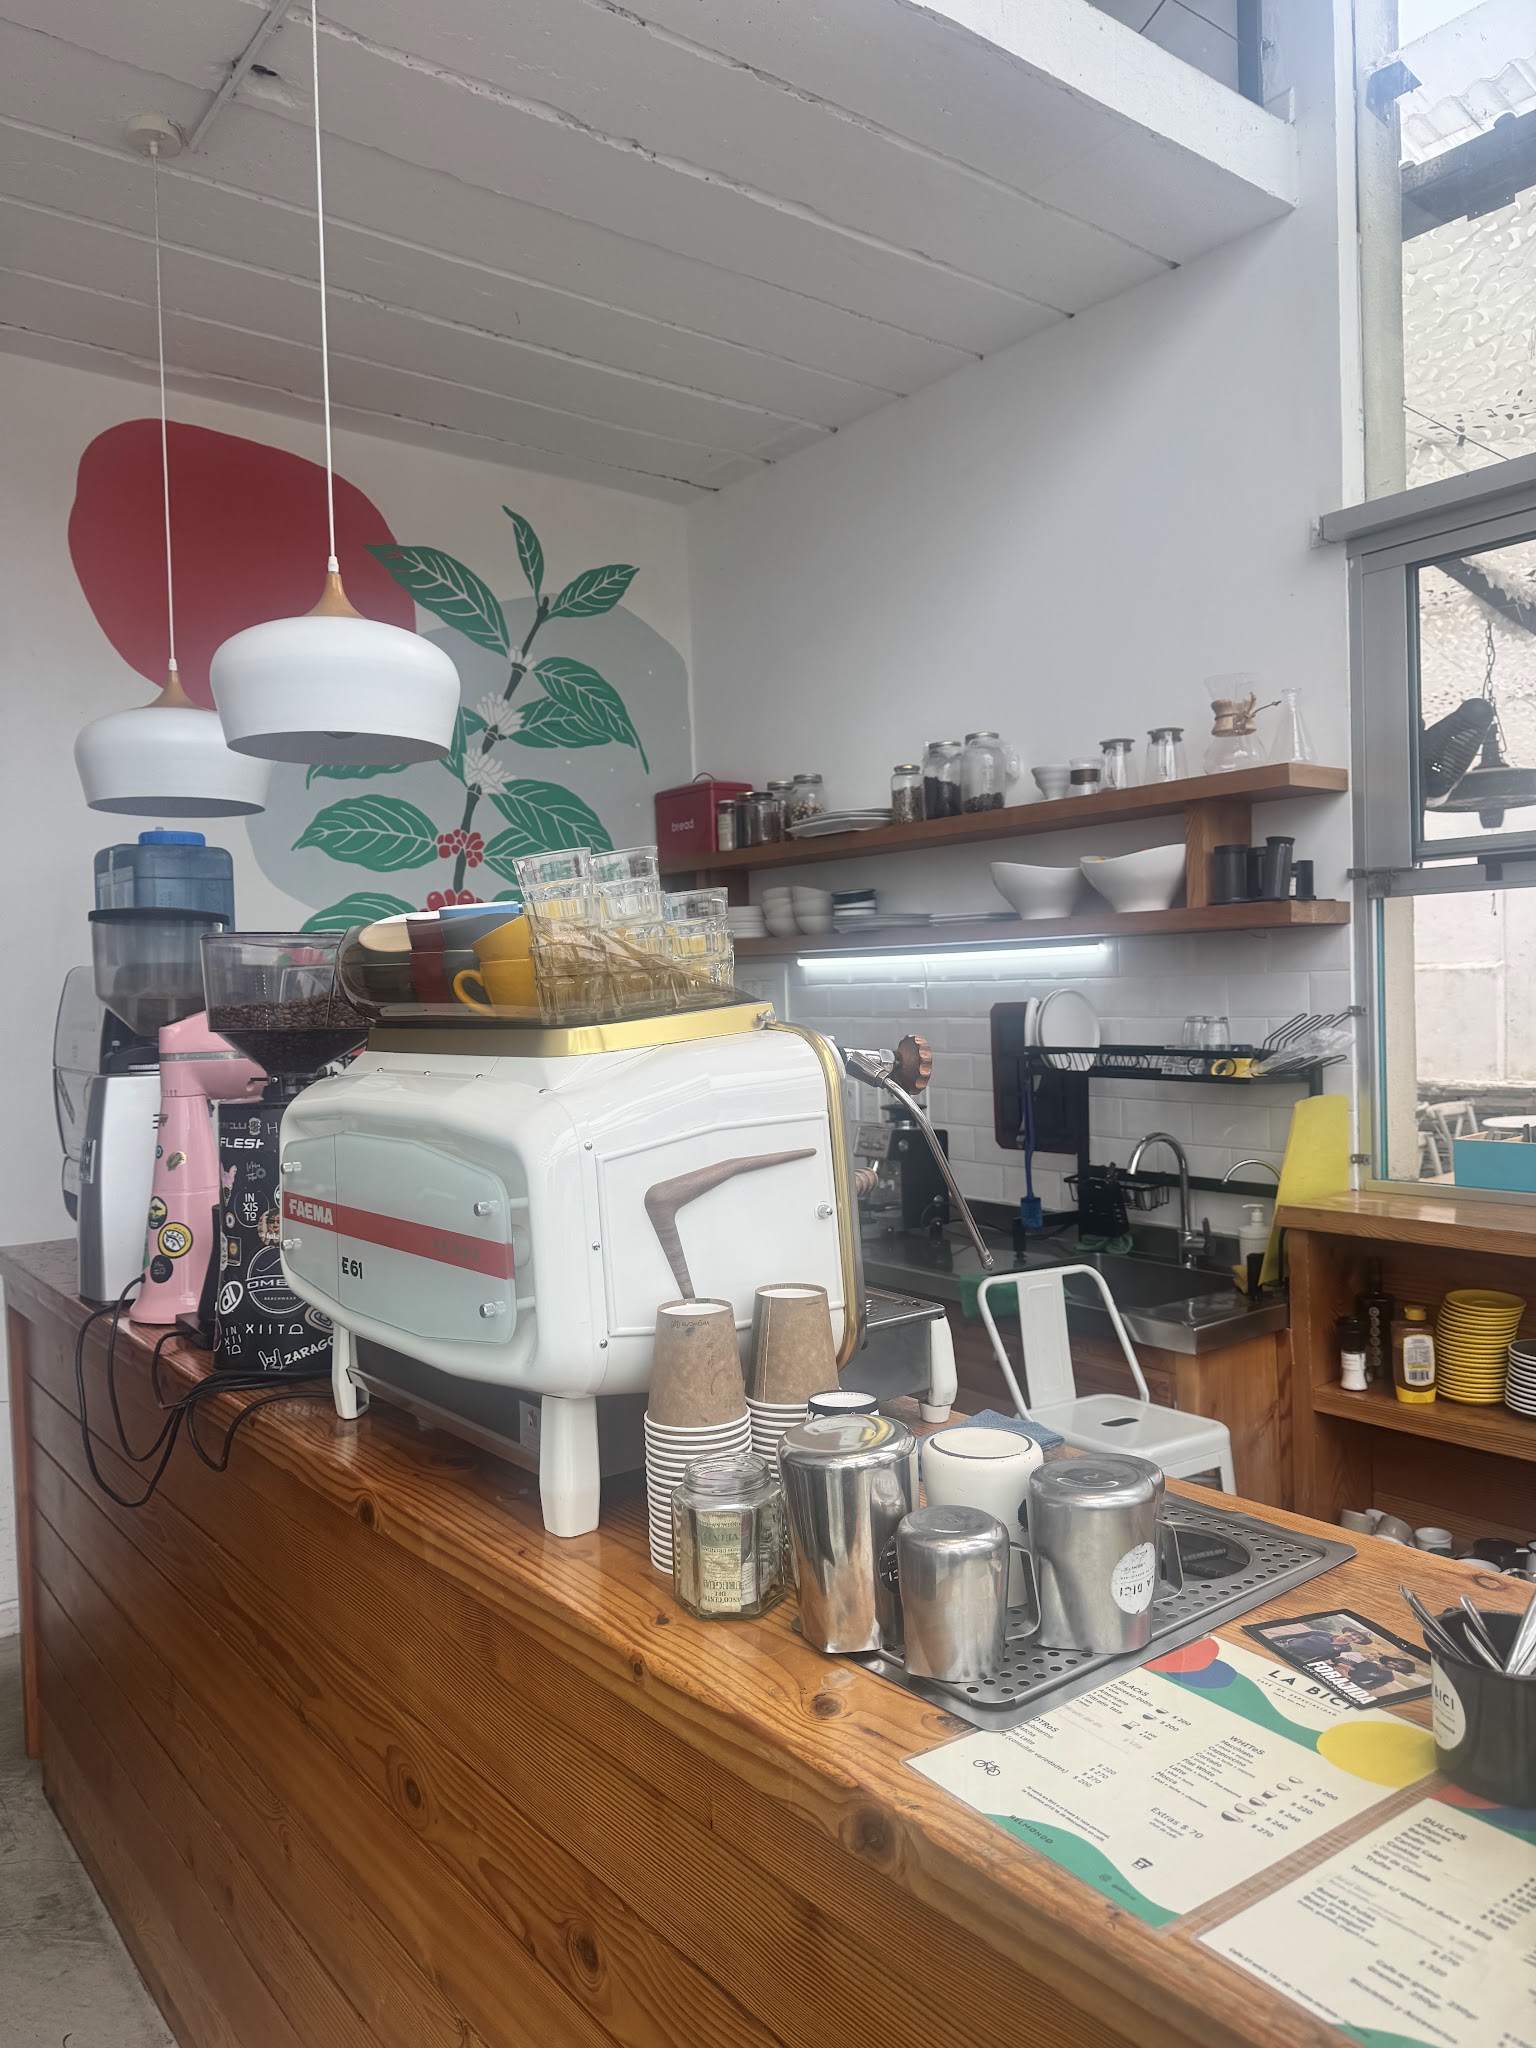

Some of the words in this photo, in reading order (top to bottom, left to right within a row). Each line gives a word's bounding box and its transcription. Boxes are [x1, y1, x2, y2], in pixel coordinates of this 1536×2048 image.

[671, 818, 694, 832] bread
[245, 1193, 254, 1202] IN
[243, 1202, 258, 1212] XIS
[289, 1199, 333, 1225] FAEMA
[703, 1579, 741, 1590] URUGUA
[1268, 1670, 1297, 1686] LA
[1306, 1660, 1378, 1705] FORAJIDA
[1097, 1689, 1129, 1705] Americano
[1164, 1723, 1180, 1731] 200
[1176, 1718, 1192, 1726] 200
[1086, 1775, 1102, 1783] 270
[1093, 1770, 1109, 1779] 270
[1102, 1766, 1117, 1775] 220
[1207, 1745, 1247, 1767] Cappuccino
[1308, 1797, 1326, 1807] 200
[1076, 1778, 1093, 1787] 200
[1181, 1758, 1196, 1766] Flat
[1194, 1765, 1215, 1776] White
[1283, 1812, 1302, 1822] 240
[1194, 1751, 1223, 1767] Cortado
[1296, 1805, 1314, 1815] 220
[1155, 1771, 1178, 1784] Mocca
[1256, 1827, 1274, 1837] 270
[1168, 1764, 1187, 1775] Latte
[1270, 1820, 1289, 1830] 240
[1321, 1791, 1339, 1800] 200
[1149, 1807, 1181, 1824] Extras
[1187, 1828, 1205, 1838] 70
[1421, 1816, 1469, 1841] DULCeS
[1385, 1840, 1421, 1859] Cookies
[1393, 1836, 1422, 1851] Carrot
[1420, 1849, 1444, 1862] Cake
[1364, 1855, 1393, 1870] Trufas
[1349, 1865, 1388, 1886] Tostadas
[1399, 1865, 1432, 1882] Canela
